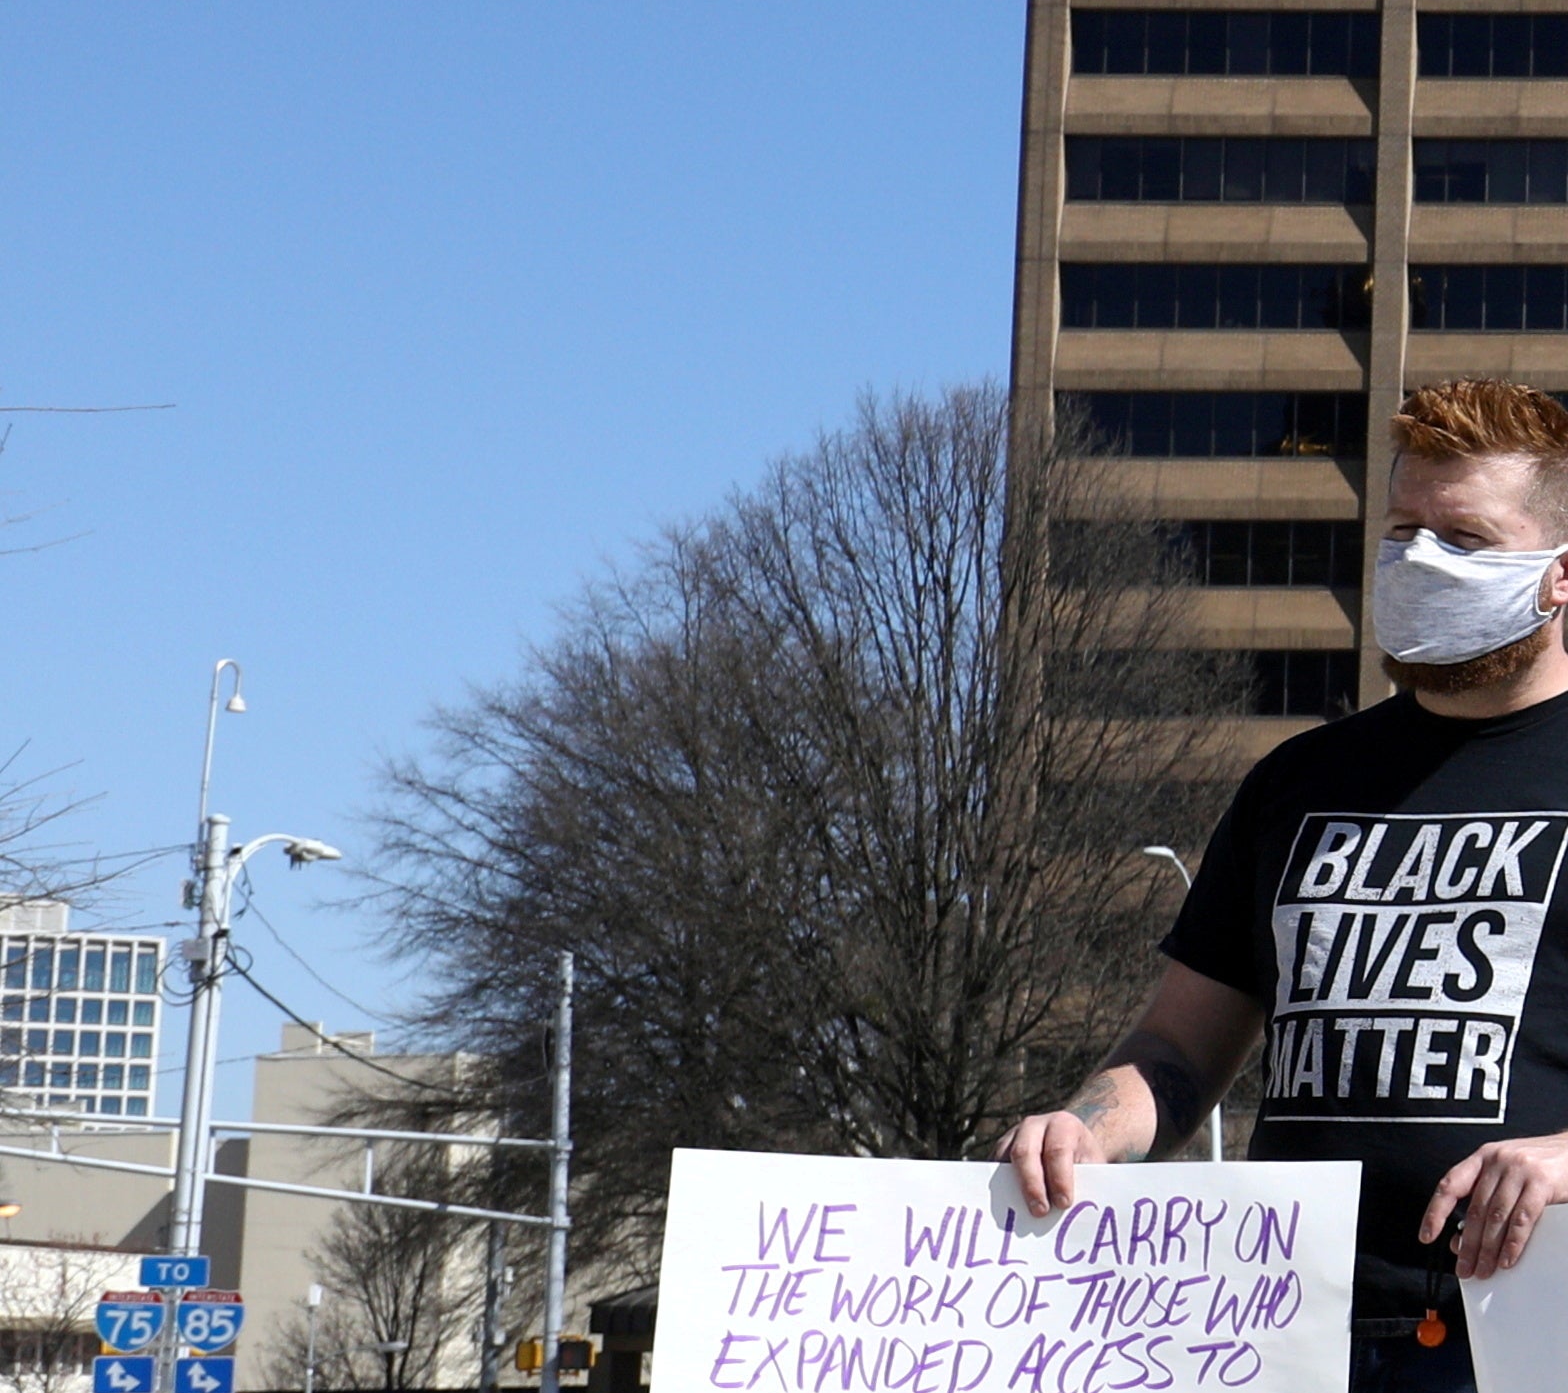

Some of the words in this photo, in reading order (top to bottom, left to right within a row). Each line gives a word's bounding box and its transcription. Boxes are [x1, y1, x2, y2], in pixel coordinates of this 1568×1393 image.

[1297, 820, 1549, 901] BLACK
[1288, 910, 1506, 1002] LIVES
[1266, 1017, 1506, 1101] MATTER
[757, 1202, 857, 1263] WE
[904, 1206, 1028, 1267] WILL
[1054, 1199, 1227, 1267] CARRY
[1234, 1200, 1299, 1264] ON
[157, 1263, 190, 1281] TO
[722, 1264, 824, 1318] THE
[830, 1272, 973, 1328] WORK
[985, 1272, 1064, 1331] OF
[1069, 1270, 1201, 1336] THOSE
[1202, 1270, 1302, 1335] WHO
[106, 1310, 153, 1346] 75
[184, 1309, 236, 1344] 85
[1187, 1341, 1262, 1387] TO
